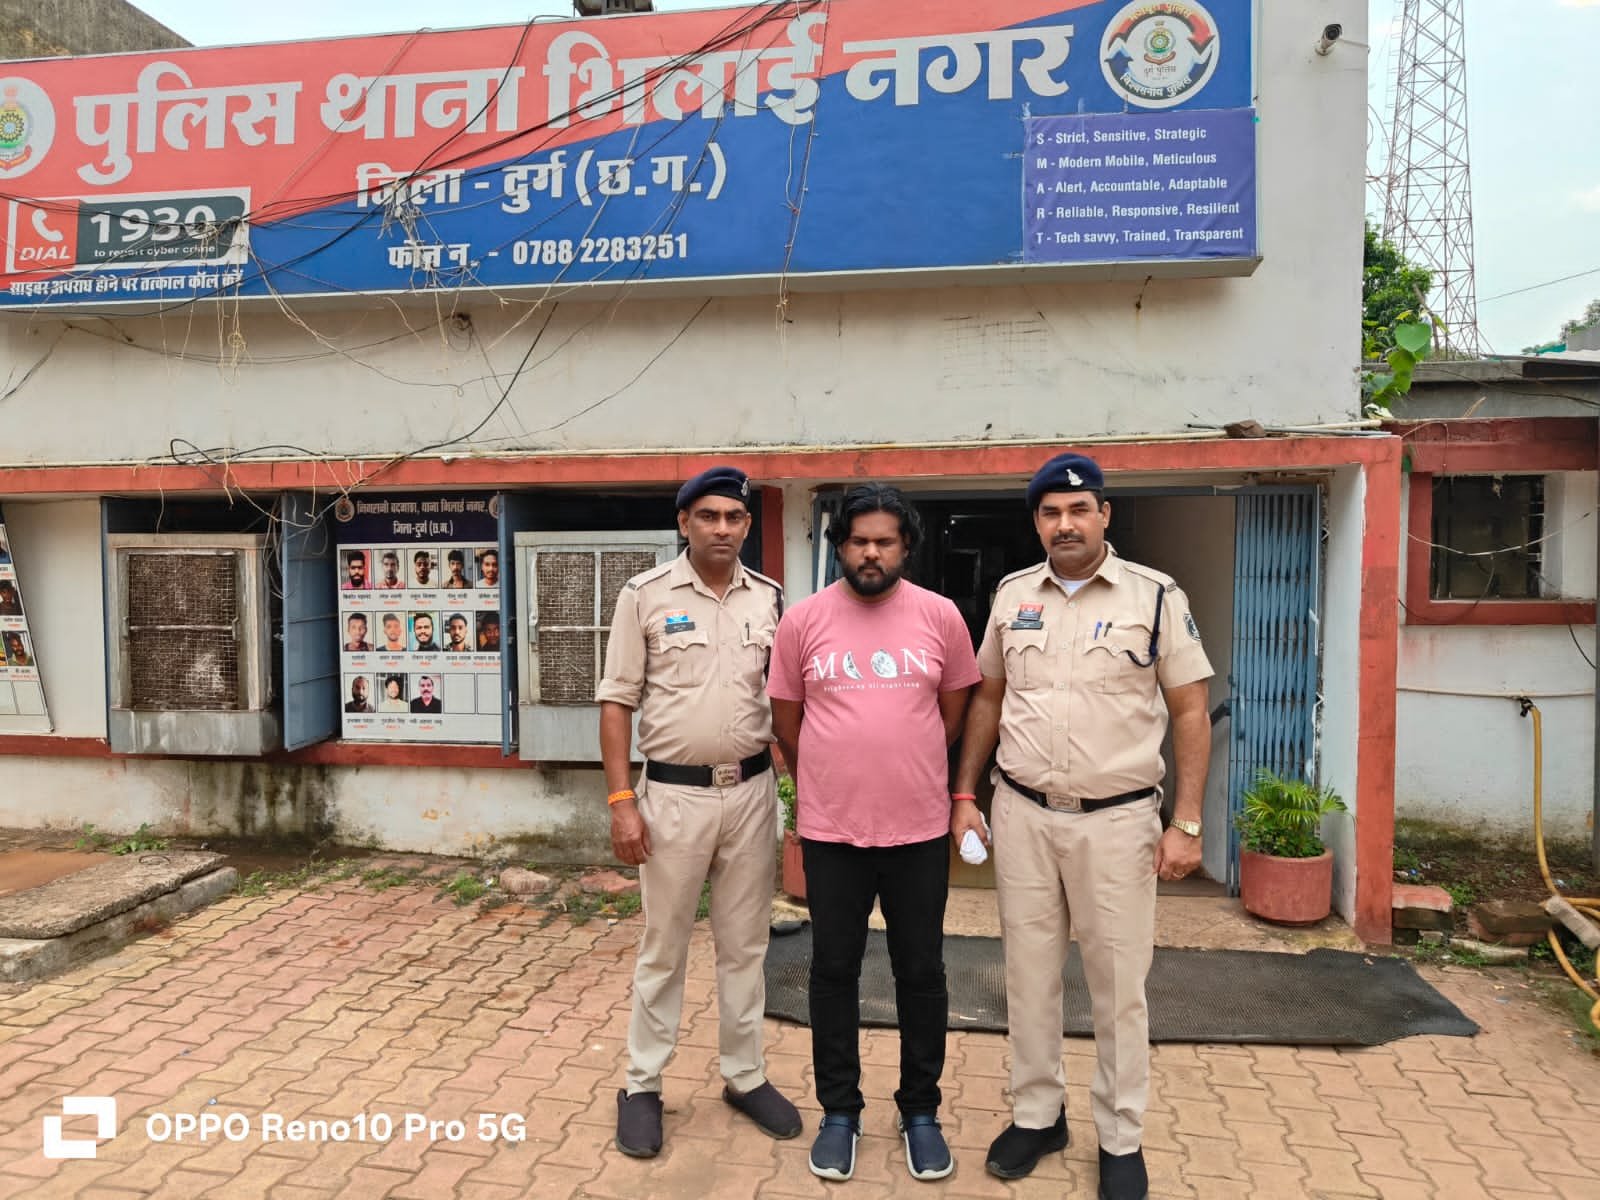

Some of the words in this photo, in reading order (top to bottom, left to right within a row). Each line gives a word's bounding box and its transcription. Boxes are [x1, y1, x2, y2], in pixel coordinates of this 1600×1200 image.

[73, 61, 302, 185] पुलिस
[320, 66, 525, 139] थाना
[543, 12, 827, 125] भिलाई
[842, 24, 1074, 105] नगर
[1036, 134, 1045, 145] S
[1055, 132, 1089, 144] Strict,
[1093, 130, 1150, 143] Sensitive,
[1154, 127, 1207, 142] Strategic
[1036, 157, 1047, 169] M
[1058, 157, 1101, 169] Modern
[1105, 155, 1149, 168] Mobile,
[1152, 152, 1217, 165] Meticulous
[501, 150, 567, 213] दुर्ग
[1036, 183, 1045, 194] A
[1055, 182, 1086, 194] Alert,
[1090, 179, 1164, 193] Accountable,
[1168, 177, 1228, 191] Adaptable
[1036, 208, 1045, 219] R
[1056, 206, 1108, 219] Reliable,
[1112, 204, 1183, 219] Responsive,
[1187, 202, 1240, 215] Resilient
[90, 204, 217, 244] 1930
[1036, 232, 1043, 244] T
[1055, 231, 1080, 243] Tech
[1083, 231, 1119, 244] savvy,
[1122, 229, 1170, 242] Trained,
[1174, 227, 1243, 242] Transparent
[19, 245, 72, 261] DIAL
[94, 249, 105, 257] to
[147, 246, 179, 257] cyber
[513, 239, 573, 265] 0788
[580, 233, 688, 263] 2283251
[121, 277, 139, 291] पर
[140, 274, 187, 291] तत्काल
[188, 271, 219, 289] कॉल
